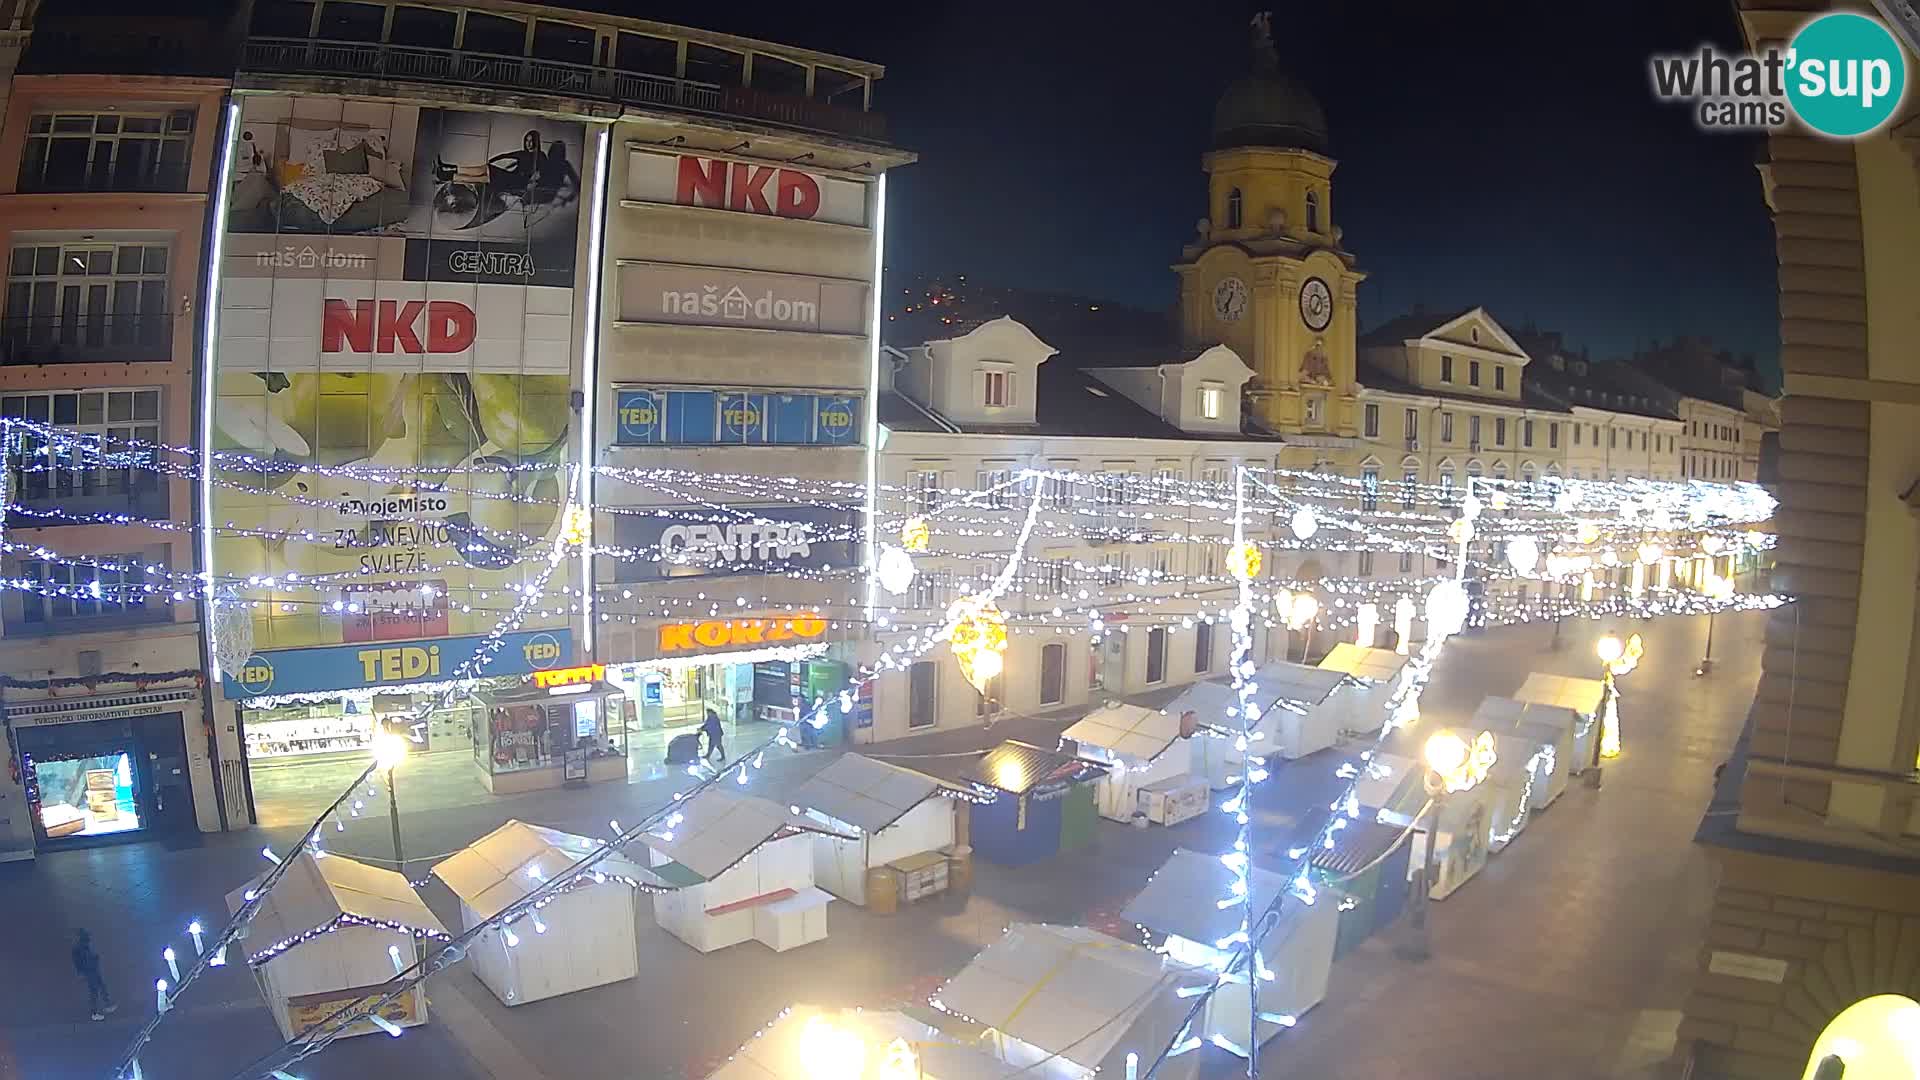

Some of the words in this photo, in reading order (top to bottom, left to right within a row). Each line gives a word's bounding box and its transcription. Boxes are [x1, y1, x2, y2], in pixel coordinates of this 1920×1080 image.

[675, 154, 820, 220] NKD
[256, 246, 293, 269] naš
[320, 247, 368, 269] dom
[448, 250, 536, 276] CENTRA
[662, 284, 720, 317] naš
[753, 293, 817, 322] dom
[321, 299, 478, 353] NKD
[619, 408, 658, 425] TEDi
[724, 409, 760, 426] TEDi
[335, 528, 358, 548] ZA
[368, 524, 450, 548] DNEVNO
[659, 522, 811, 564] CENTRA
[360, 547, 427, 574] SVJEŽE
[660, 612, 828, 652] KORZO
[359, 645, 441, 681] TEDi
[523, 643, 561, 659] TEDi
[533, 664, 606, 688] TOMMY
